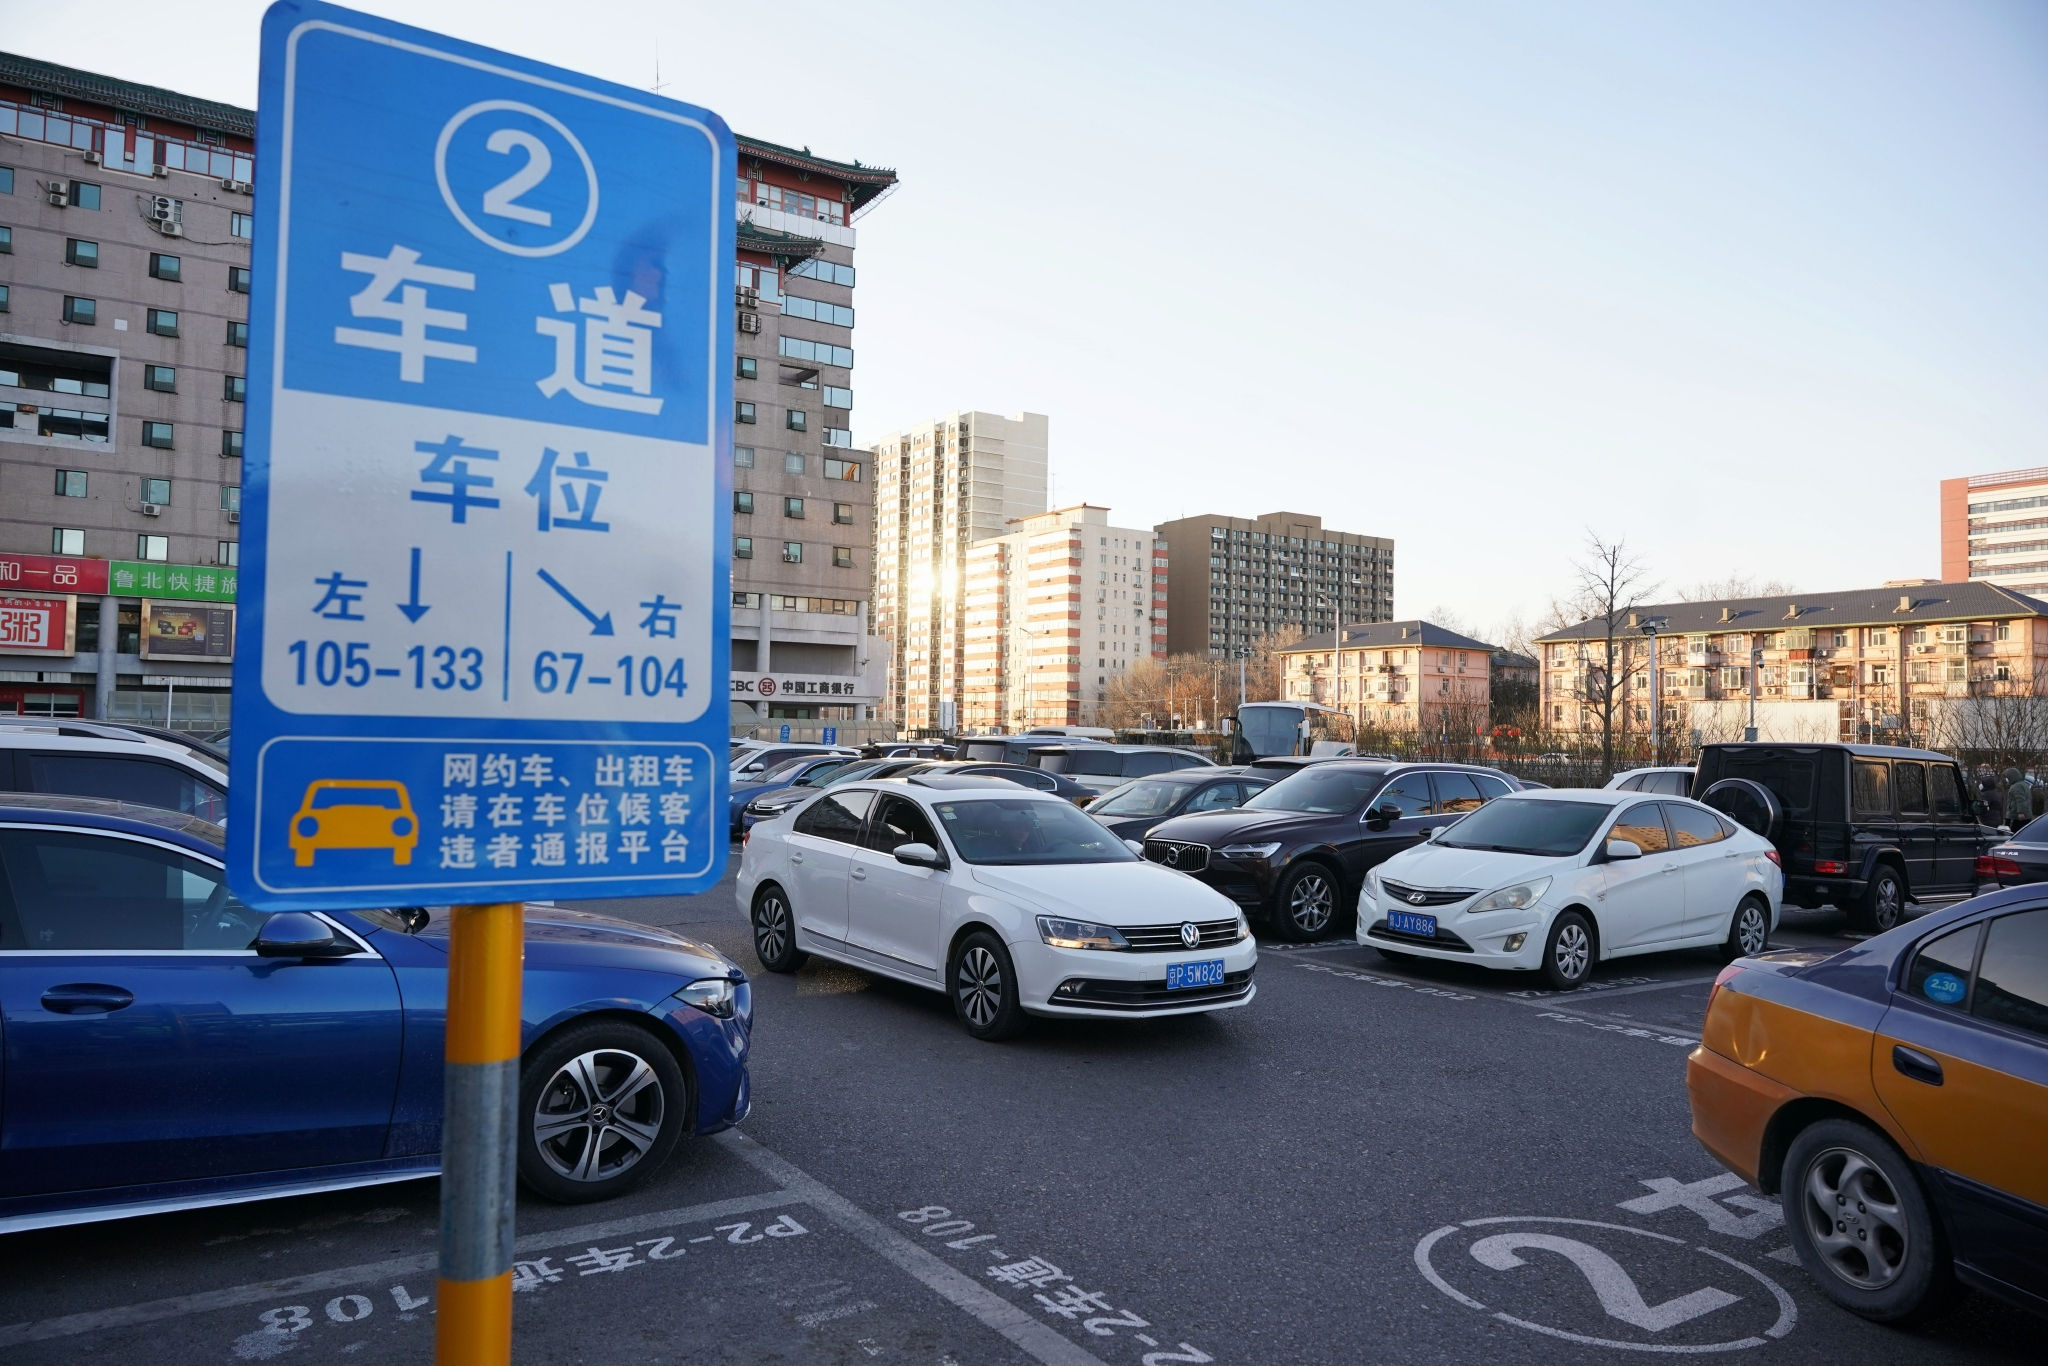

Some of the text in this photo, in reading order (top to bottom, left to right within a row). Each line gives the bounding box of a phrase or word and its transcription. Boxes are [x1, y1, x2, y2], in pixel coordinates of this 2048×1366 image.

[335, 244, 664, 415] 车道
[411, 435, 610, 532] 车位
[0, 561, 77, 585] 和一品
[312, 571, 369, 622] 左
[639, 594, 683, 639] 右
[288, 640, 484, 691] 105-133
[533, 651, 688, 698] 67-104
[782, 681, 855, 694] 中国工商银行
[443, 754, 694, 788] 网约车、出租车
[440, 793, 691, 828] 请在车位候客
[439, 829, 690, 869] 违者通报平台
